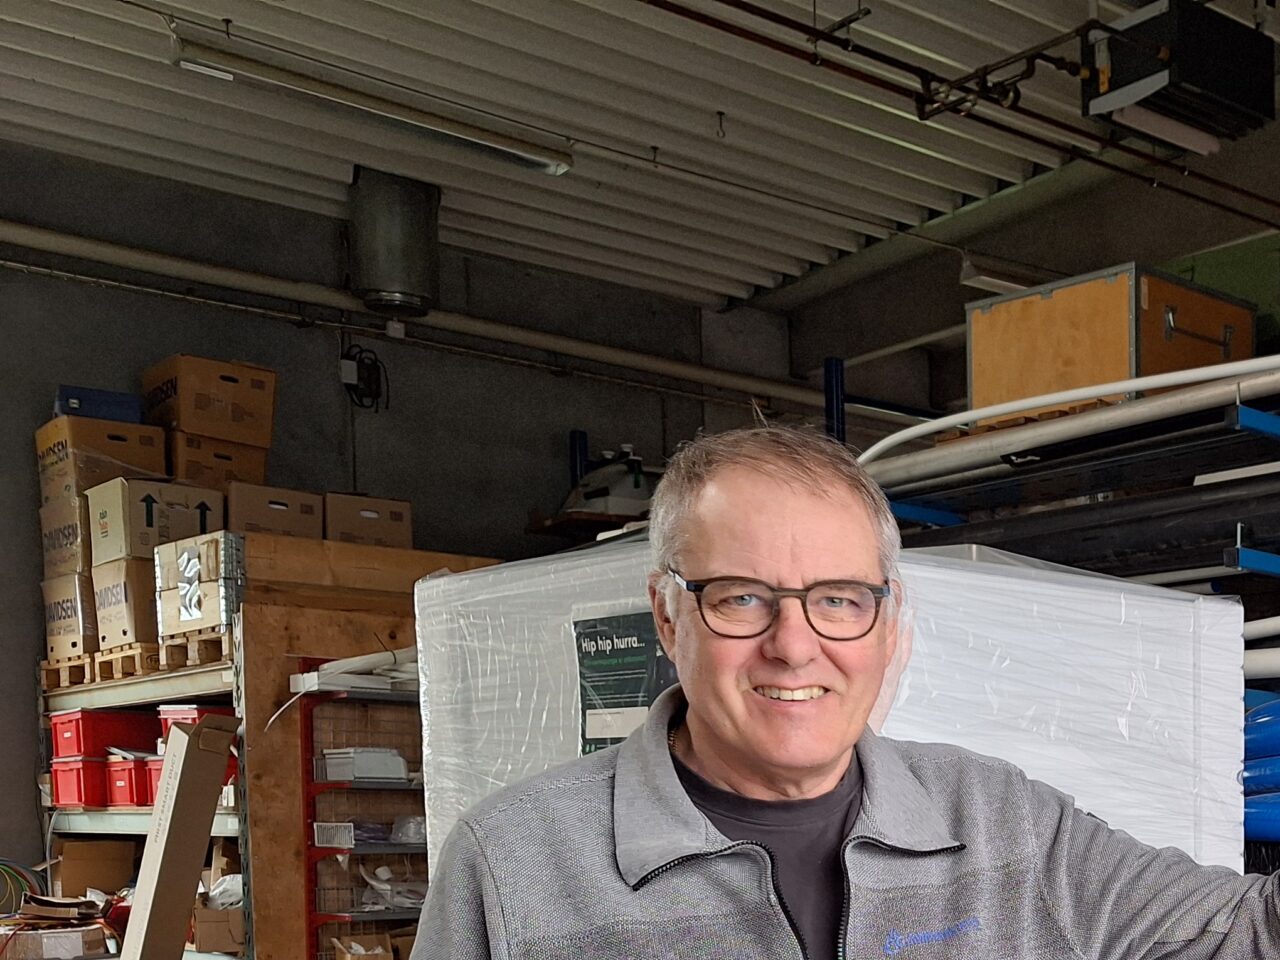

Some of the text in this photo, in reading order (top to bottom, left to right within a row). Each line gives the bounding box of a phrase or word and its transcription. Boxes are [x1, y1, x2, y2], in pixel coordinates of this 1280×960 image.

[581, 633, 646, 655] Hip hip hurra...
